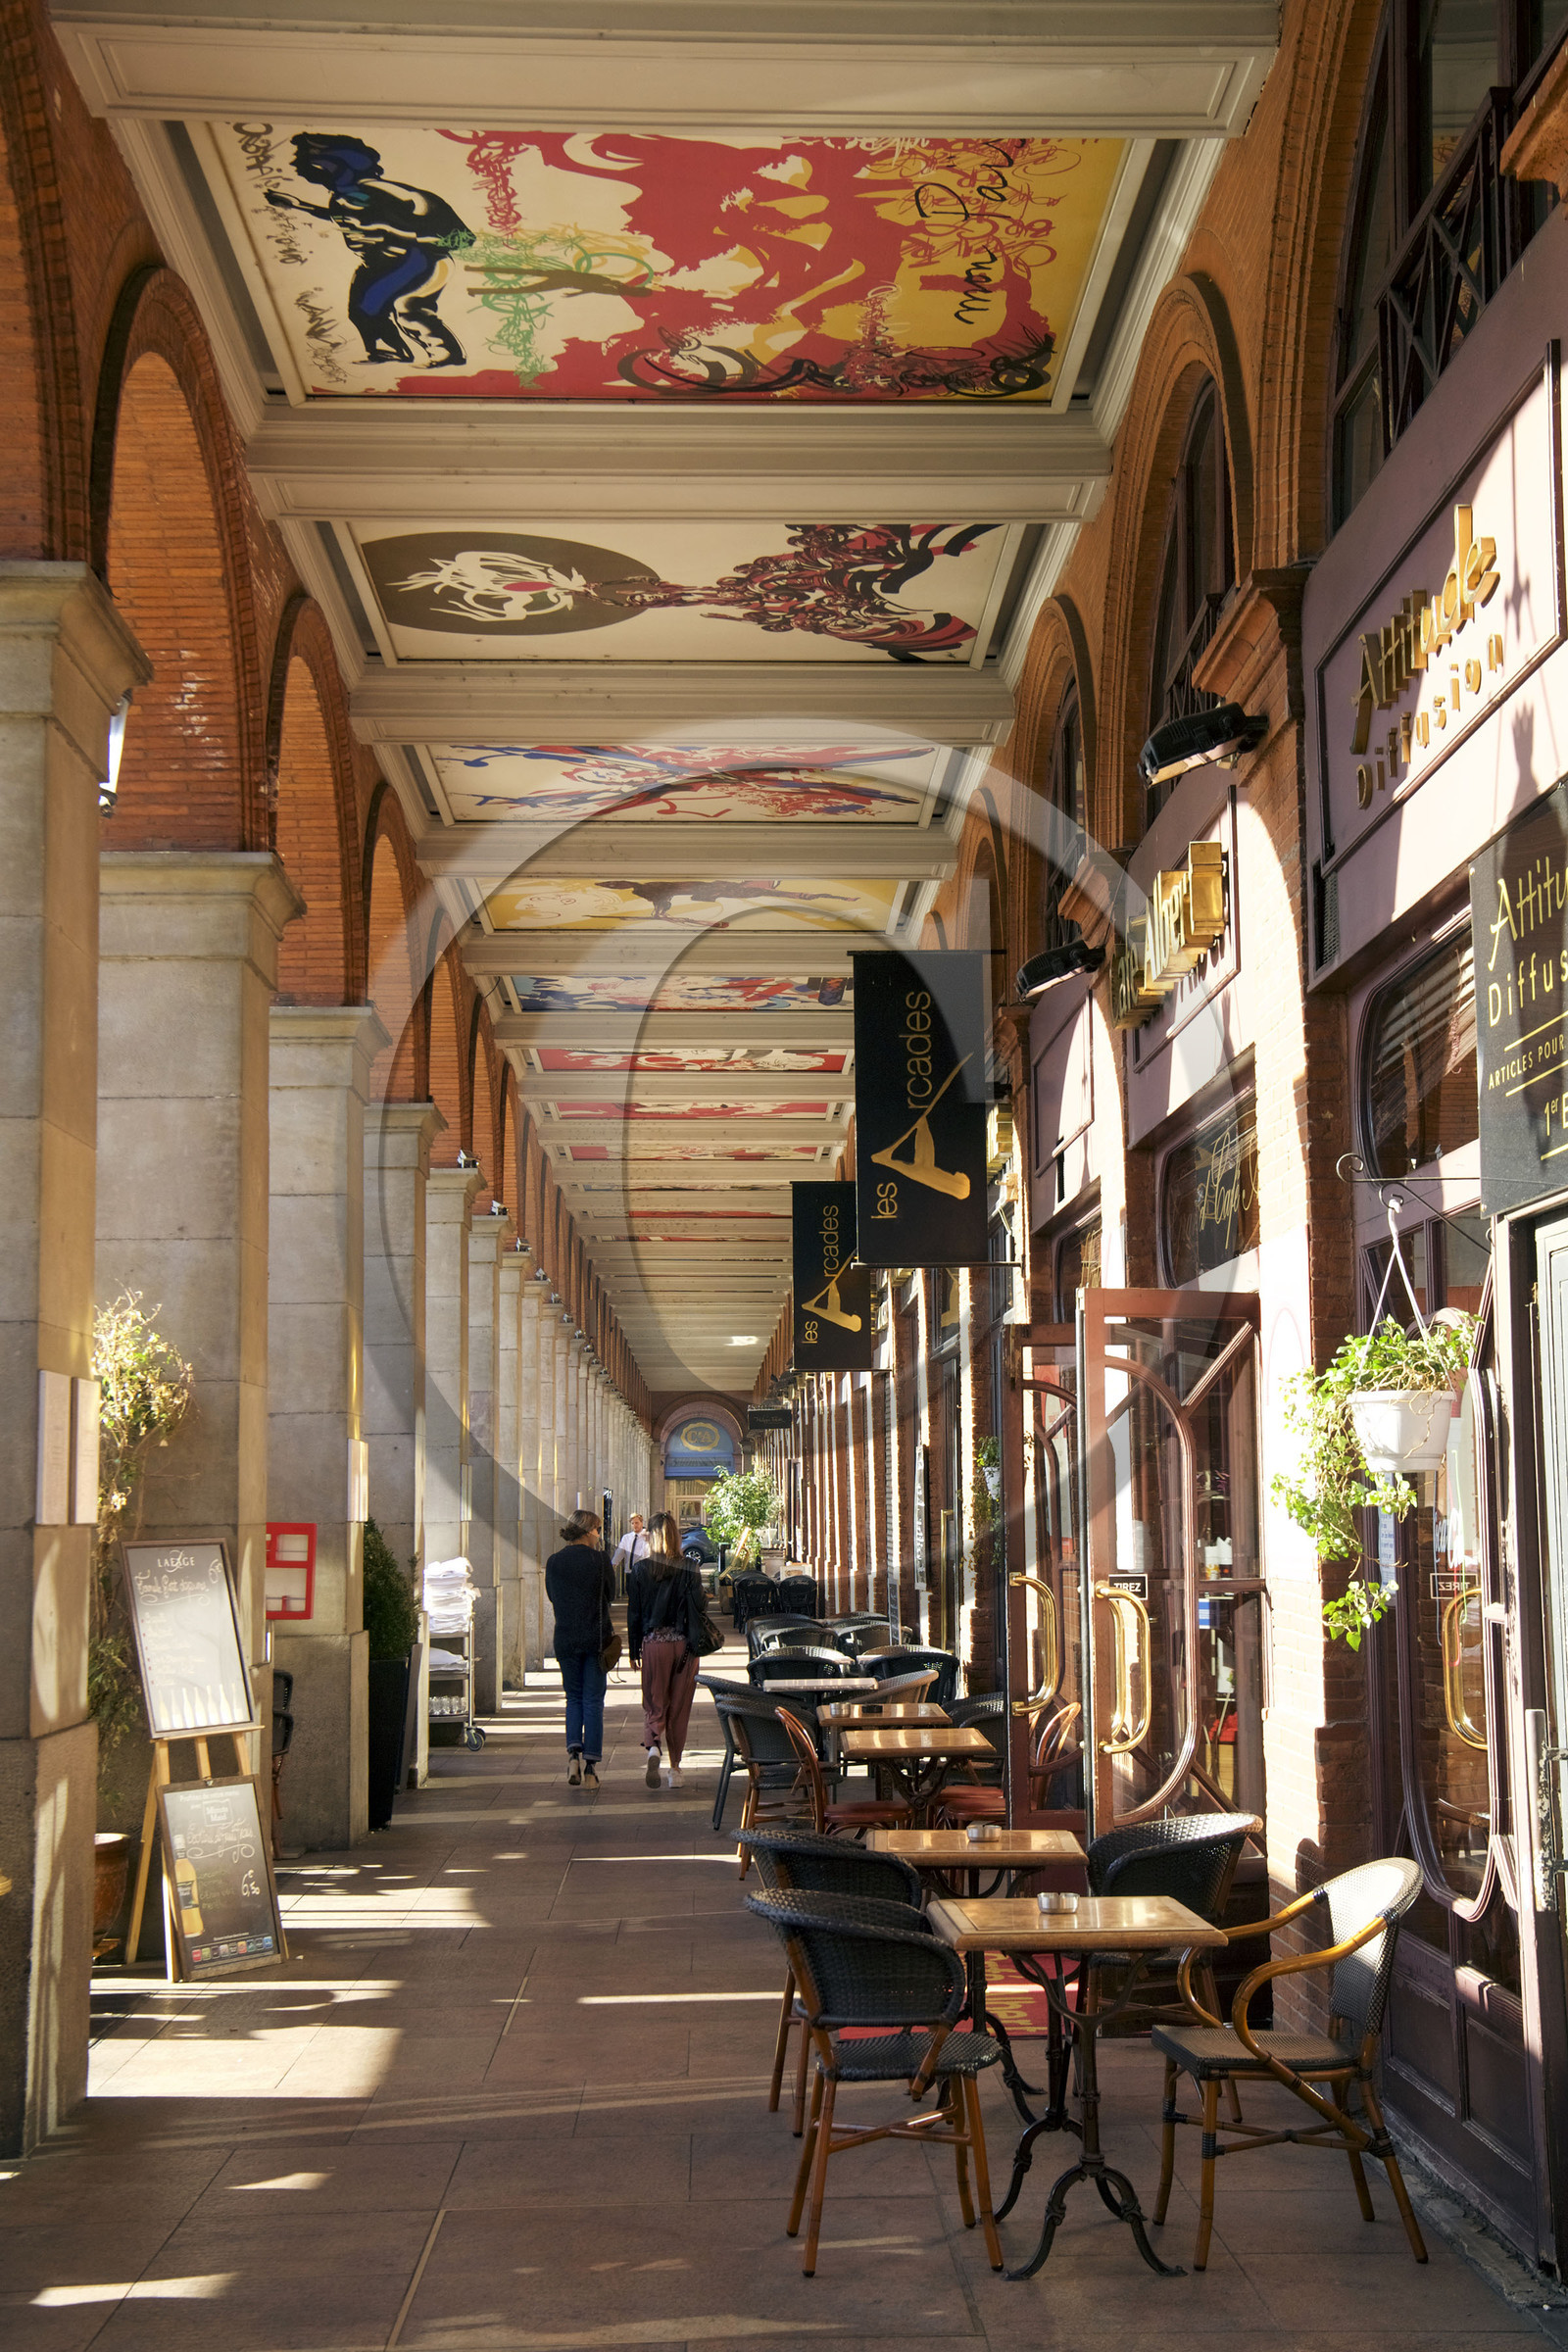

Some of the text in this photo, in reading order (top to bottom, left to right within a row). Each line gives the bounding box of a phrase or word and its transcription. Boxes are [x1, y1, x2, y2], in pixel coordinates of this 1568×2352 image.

[1349, 504, 1500, 756] Attitude
[1356, 633, 1503, 809] Diffusion
[1489, 1033, 1565, 1091] ARTICLES POUR
[871, 1182, 899, 1220] les
[802, 1320, 818, 1345] les
